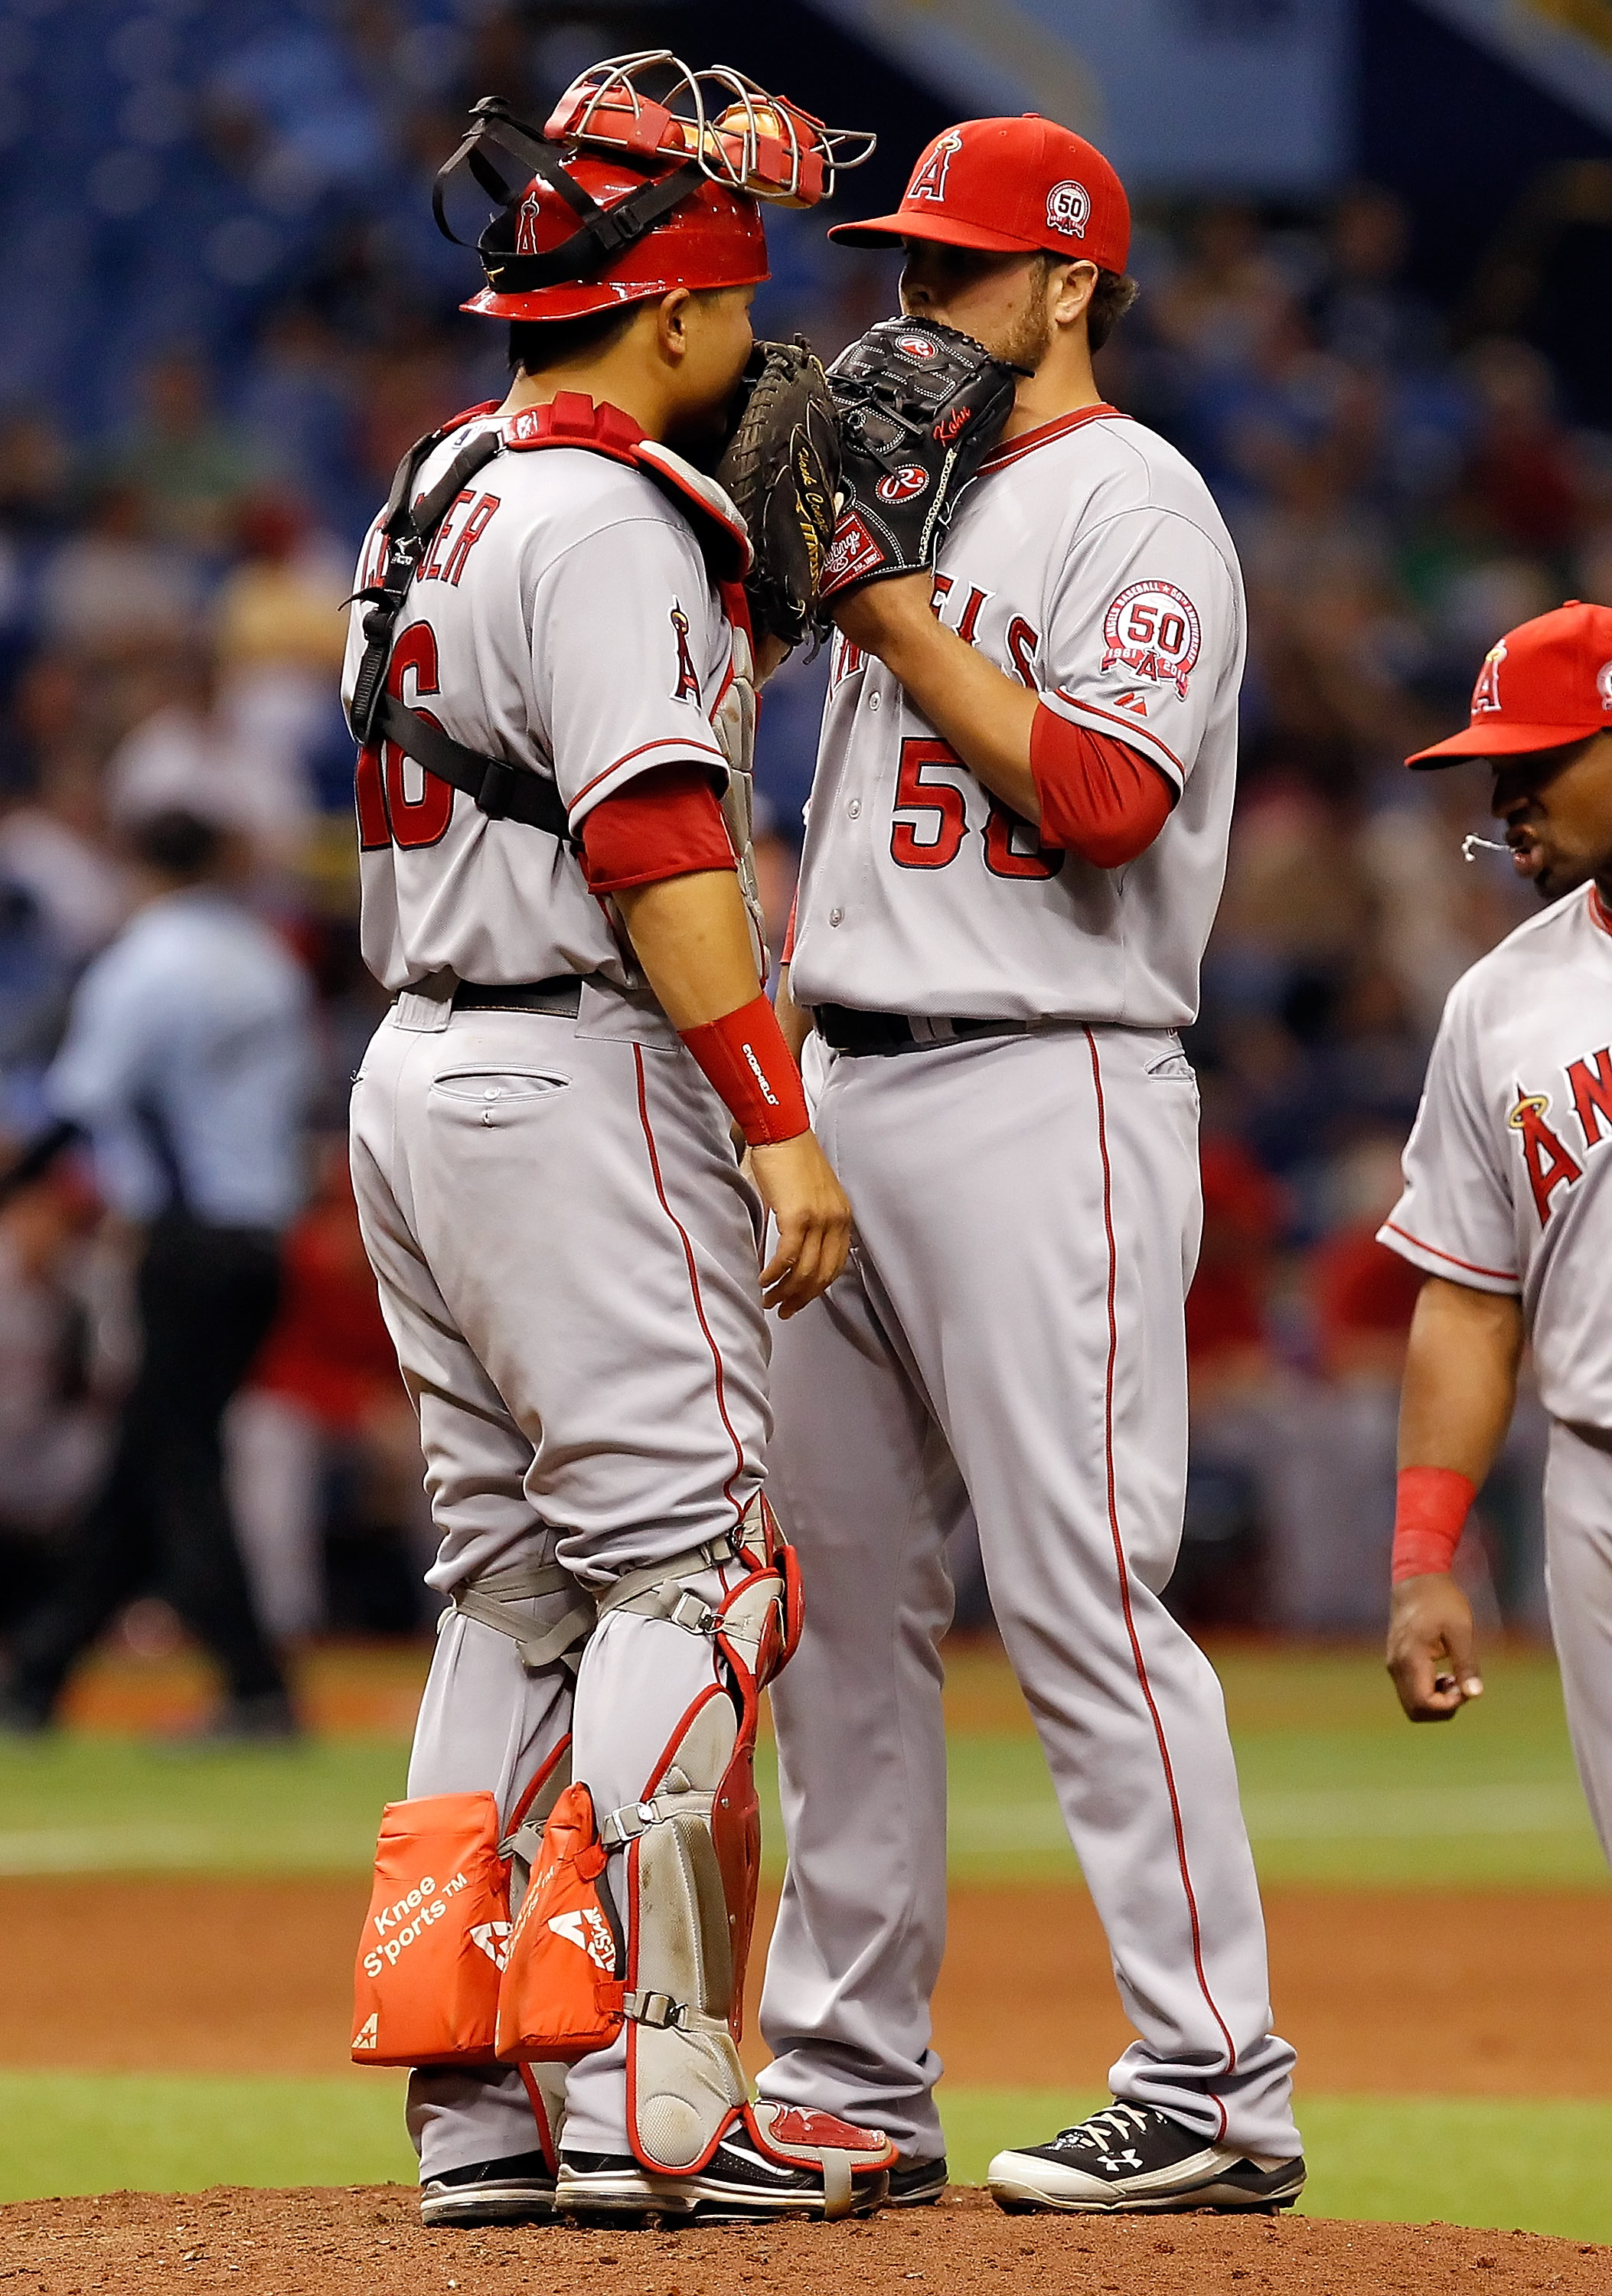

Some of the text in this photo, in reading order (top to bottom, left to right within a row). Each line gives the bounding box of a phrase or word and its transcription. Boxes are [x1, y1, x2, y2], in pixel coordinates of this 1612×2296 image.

[907, 129, 963, 201] A
[1058, 193, 1082, 217] 50
[1107, 582, 1160, 638] ANGELS BASEBALL
[1128, 604, 1185, 655] 50
[1184, 605, 1200, 665] ANNIVERSARY
[667, 595, 702, 710] A
[1108, 647, 1137, 658] 1961
[1163, 660, 1186, 683] 2011
[1471, 638, 1508, 715] A
[374, 1876, 436, 1936] Knee
[363, 1899, 446, 1978] S'ports
